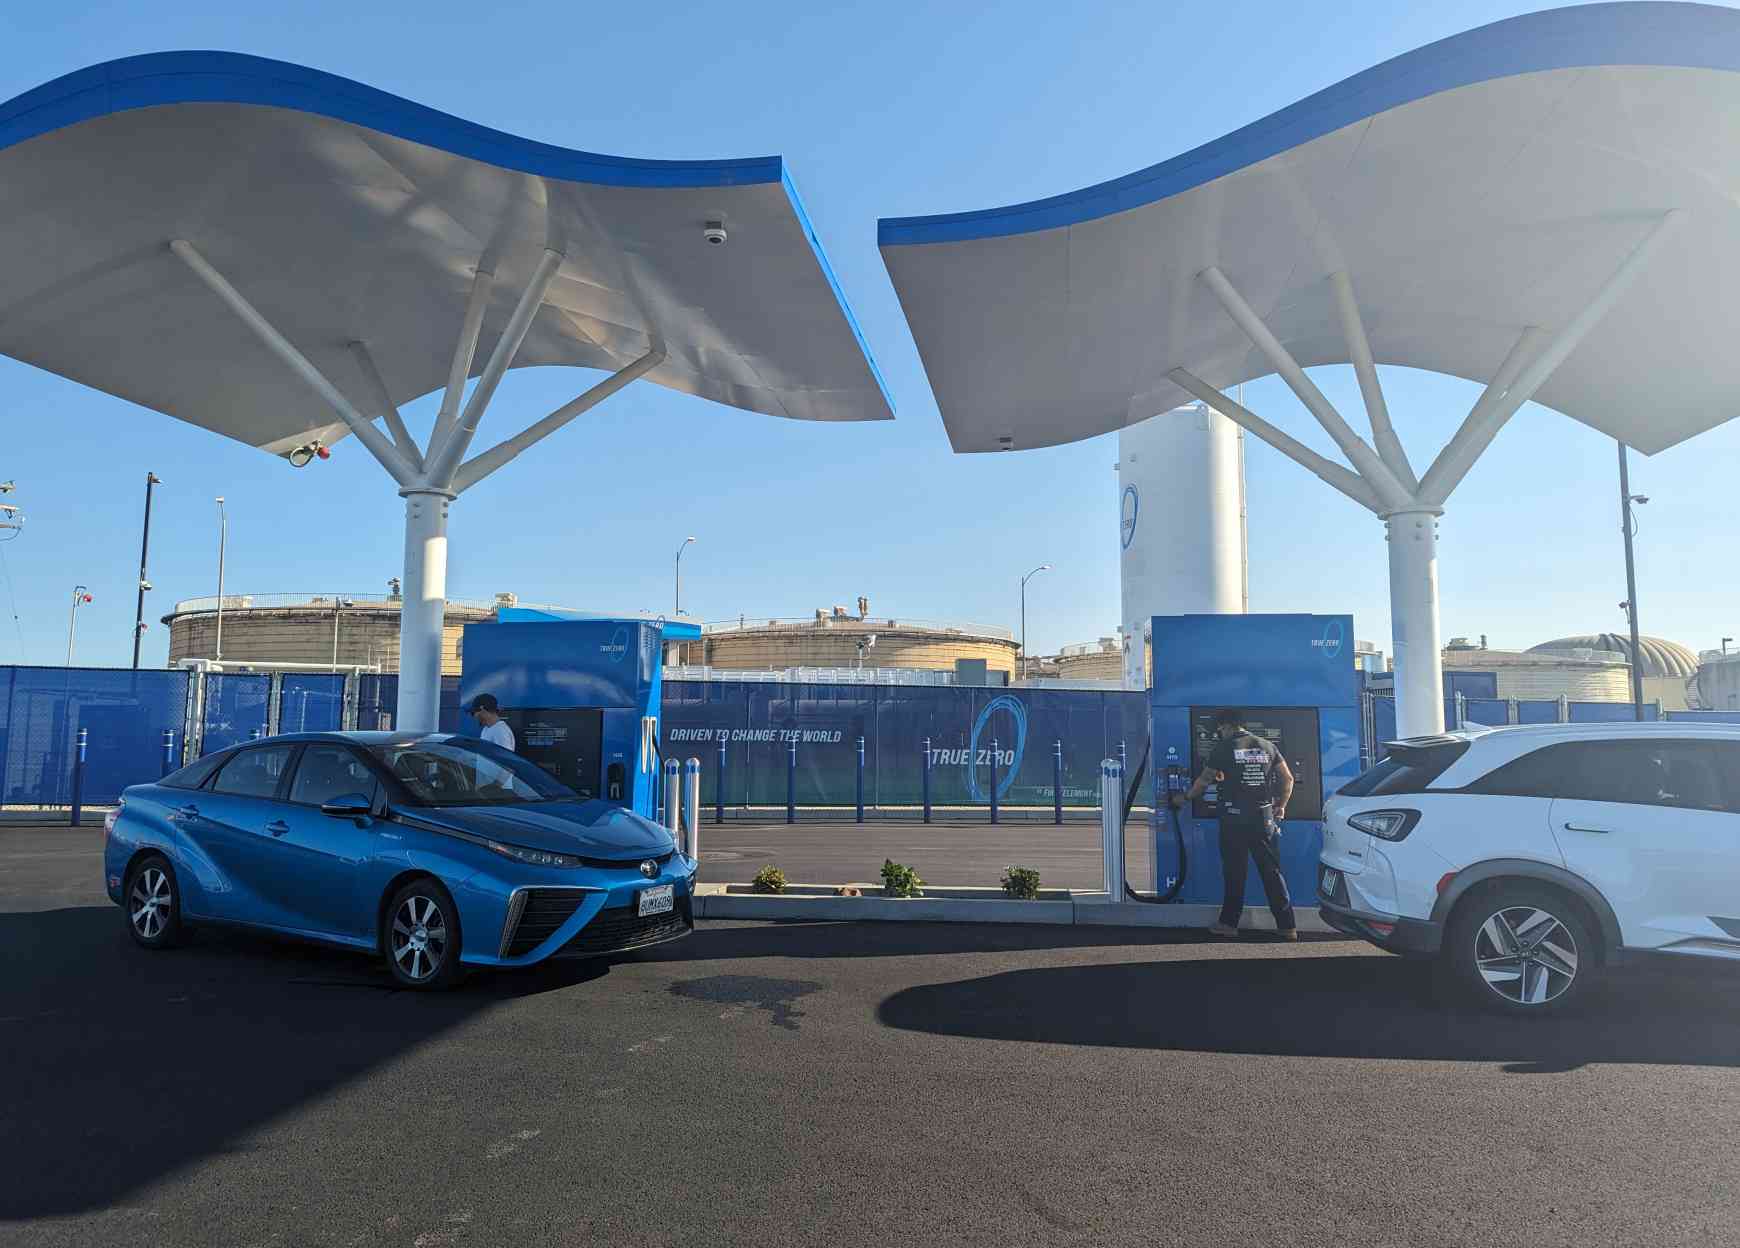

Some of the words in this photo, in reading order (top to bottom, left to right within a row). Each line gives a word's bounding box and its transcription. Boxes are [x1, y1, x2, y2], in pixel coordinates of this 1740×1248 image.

[670, 728, 712, 741] DRIVEN
[715, 728, 730, 741] TO
[731, 729, 778, 742] CHANGE
[779, 729, 800, 742] THE
[802, 730, 842, 743] WORLD
[932, 749, 970, 765] TRUE
